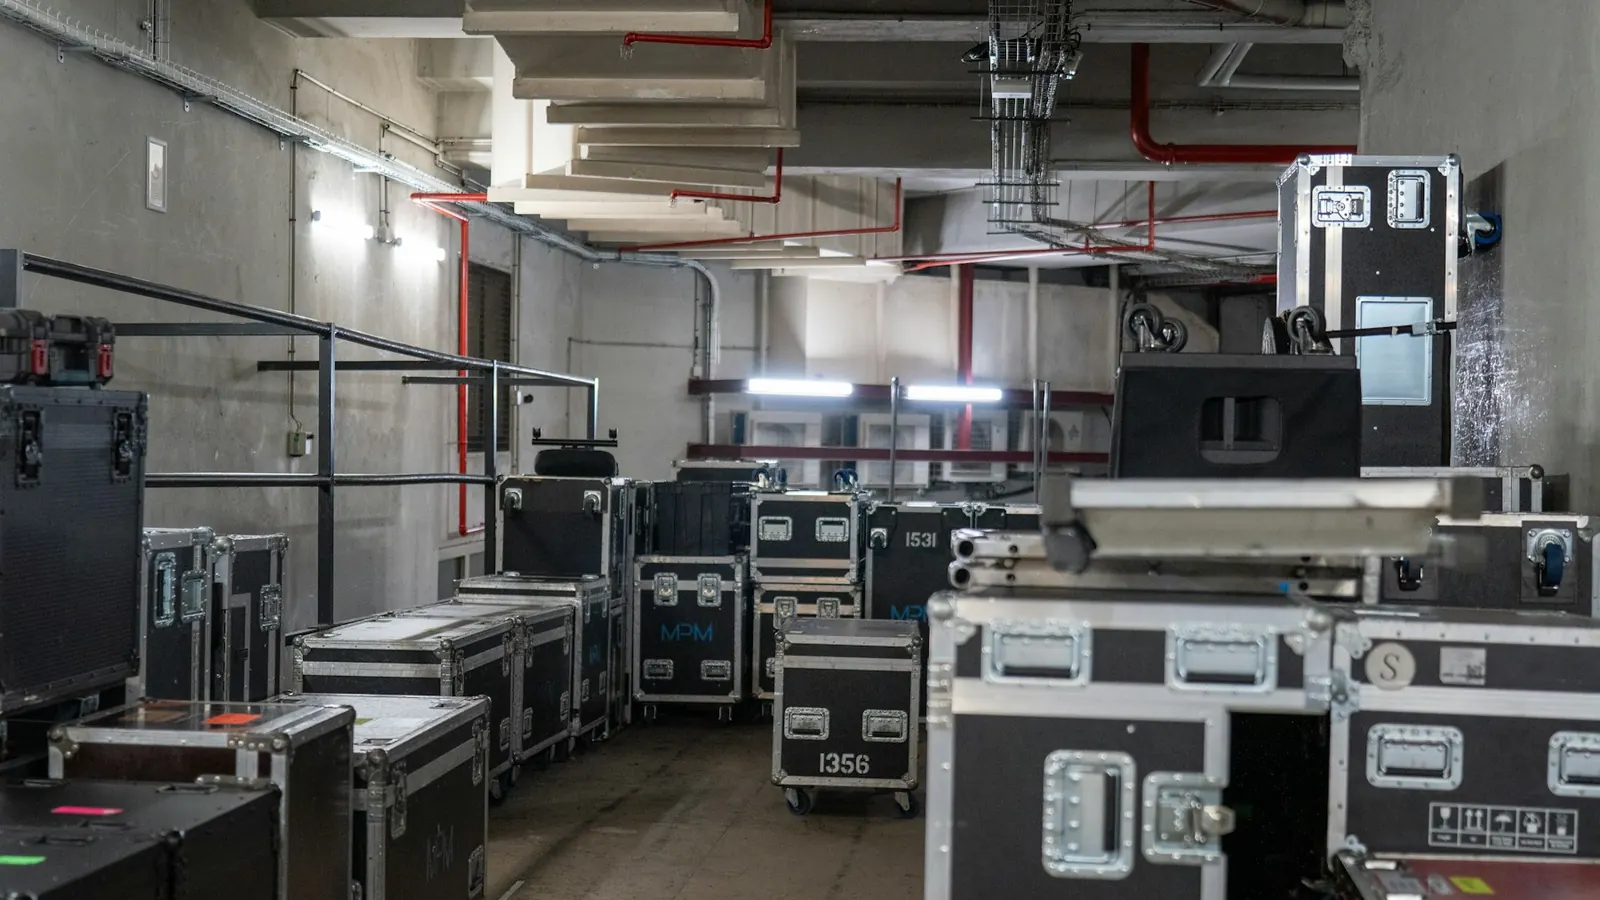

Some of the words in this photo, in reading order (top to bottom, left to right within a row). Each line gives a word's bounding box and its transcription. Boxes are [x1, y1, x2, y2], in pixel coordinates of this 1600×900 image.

[906, 531, 937, 548] 1531
[890, 604, 928, 620] MP
[660, 621, 714, 642] MPM
[819, 752, 870, 774] 1356
